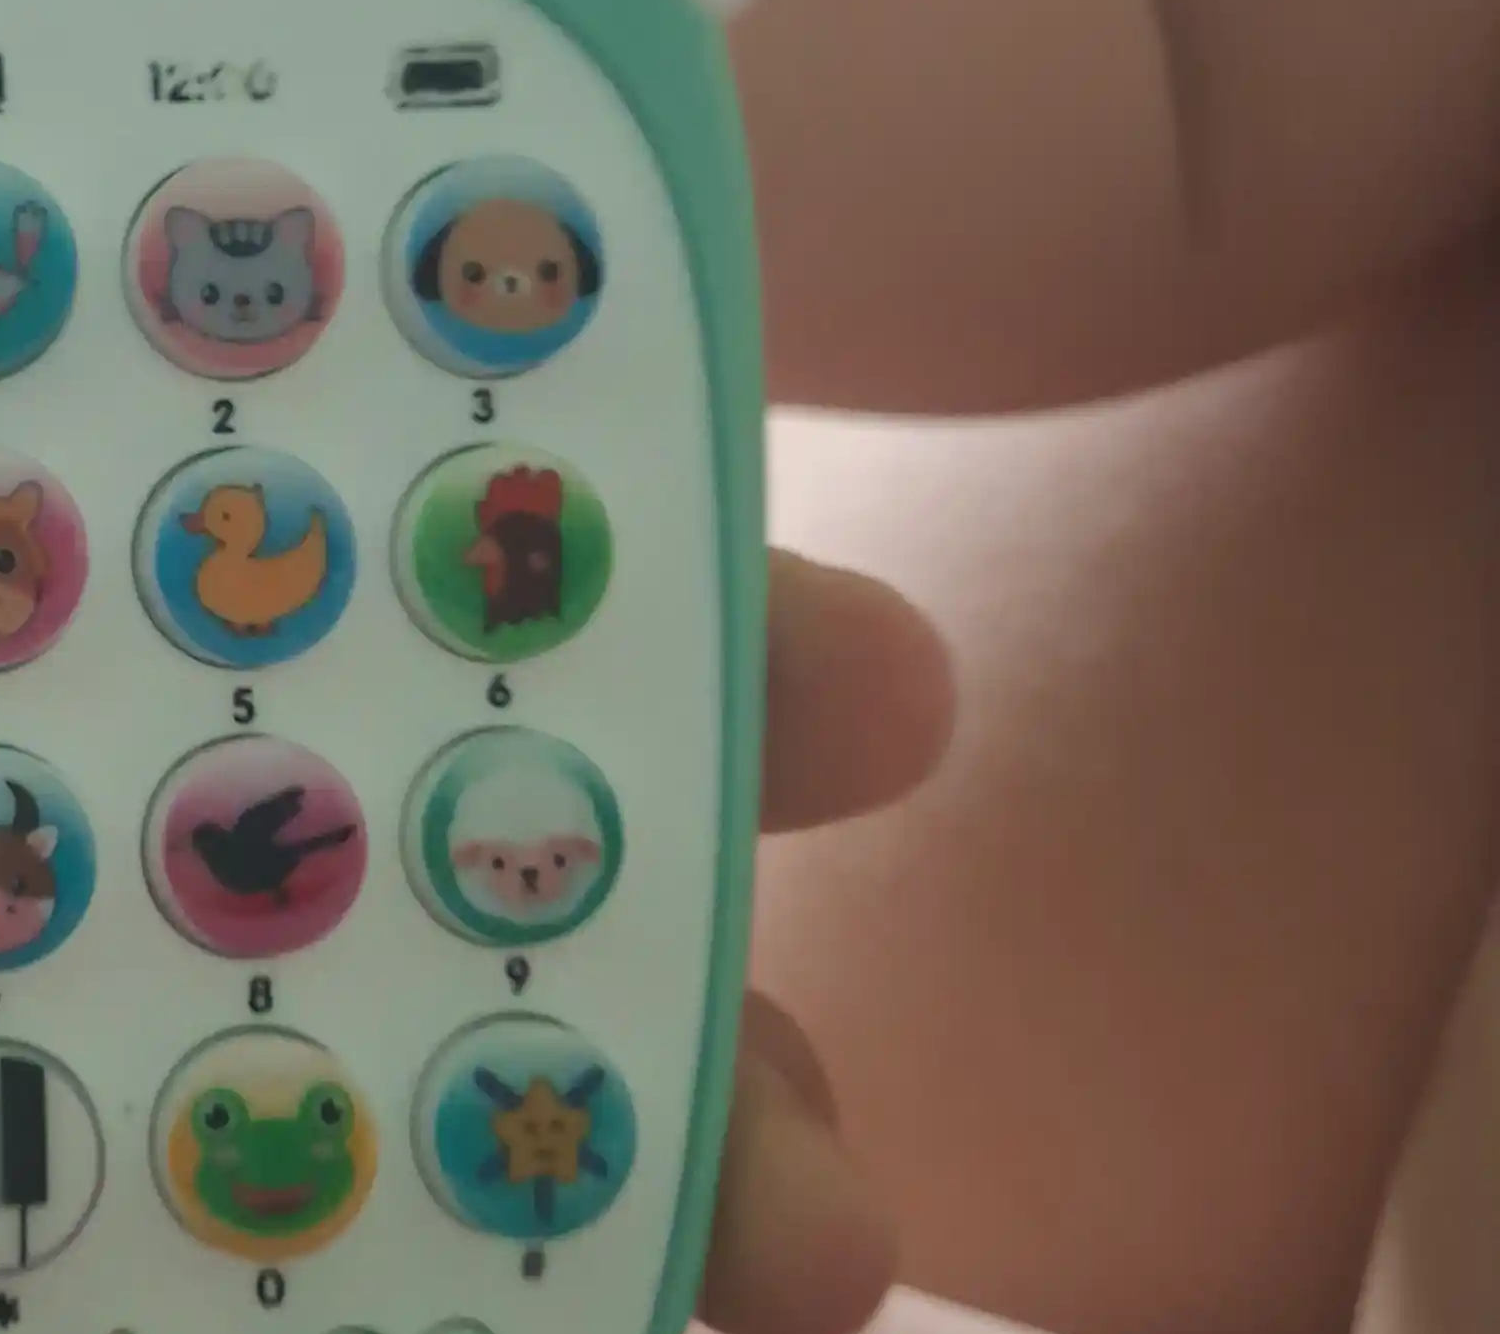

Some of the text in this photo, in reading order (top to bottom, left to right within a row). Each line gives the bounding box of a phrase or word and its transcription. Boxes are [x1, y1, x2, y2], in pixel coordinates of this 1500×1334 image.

[211, 397, 237, 435] 2
[470, 387, 495, 424] 3
[231, 686, 257, 726] 5
[486, 673, 513, 710] 6
[504, 954, 531, 994] 9
[247, 975, 274, 1015] 8
